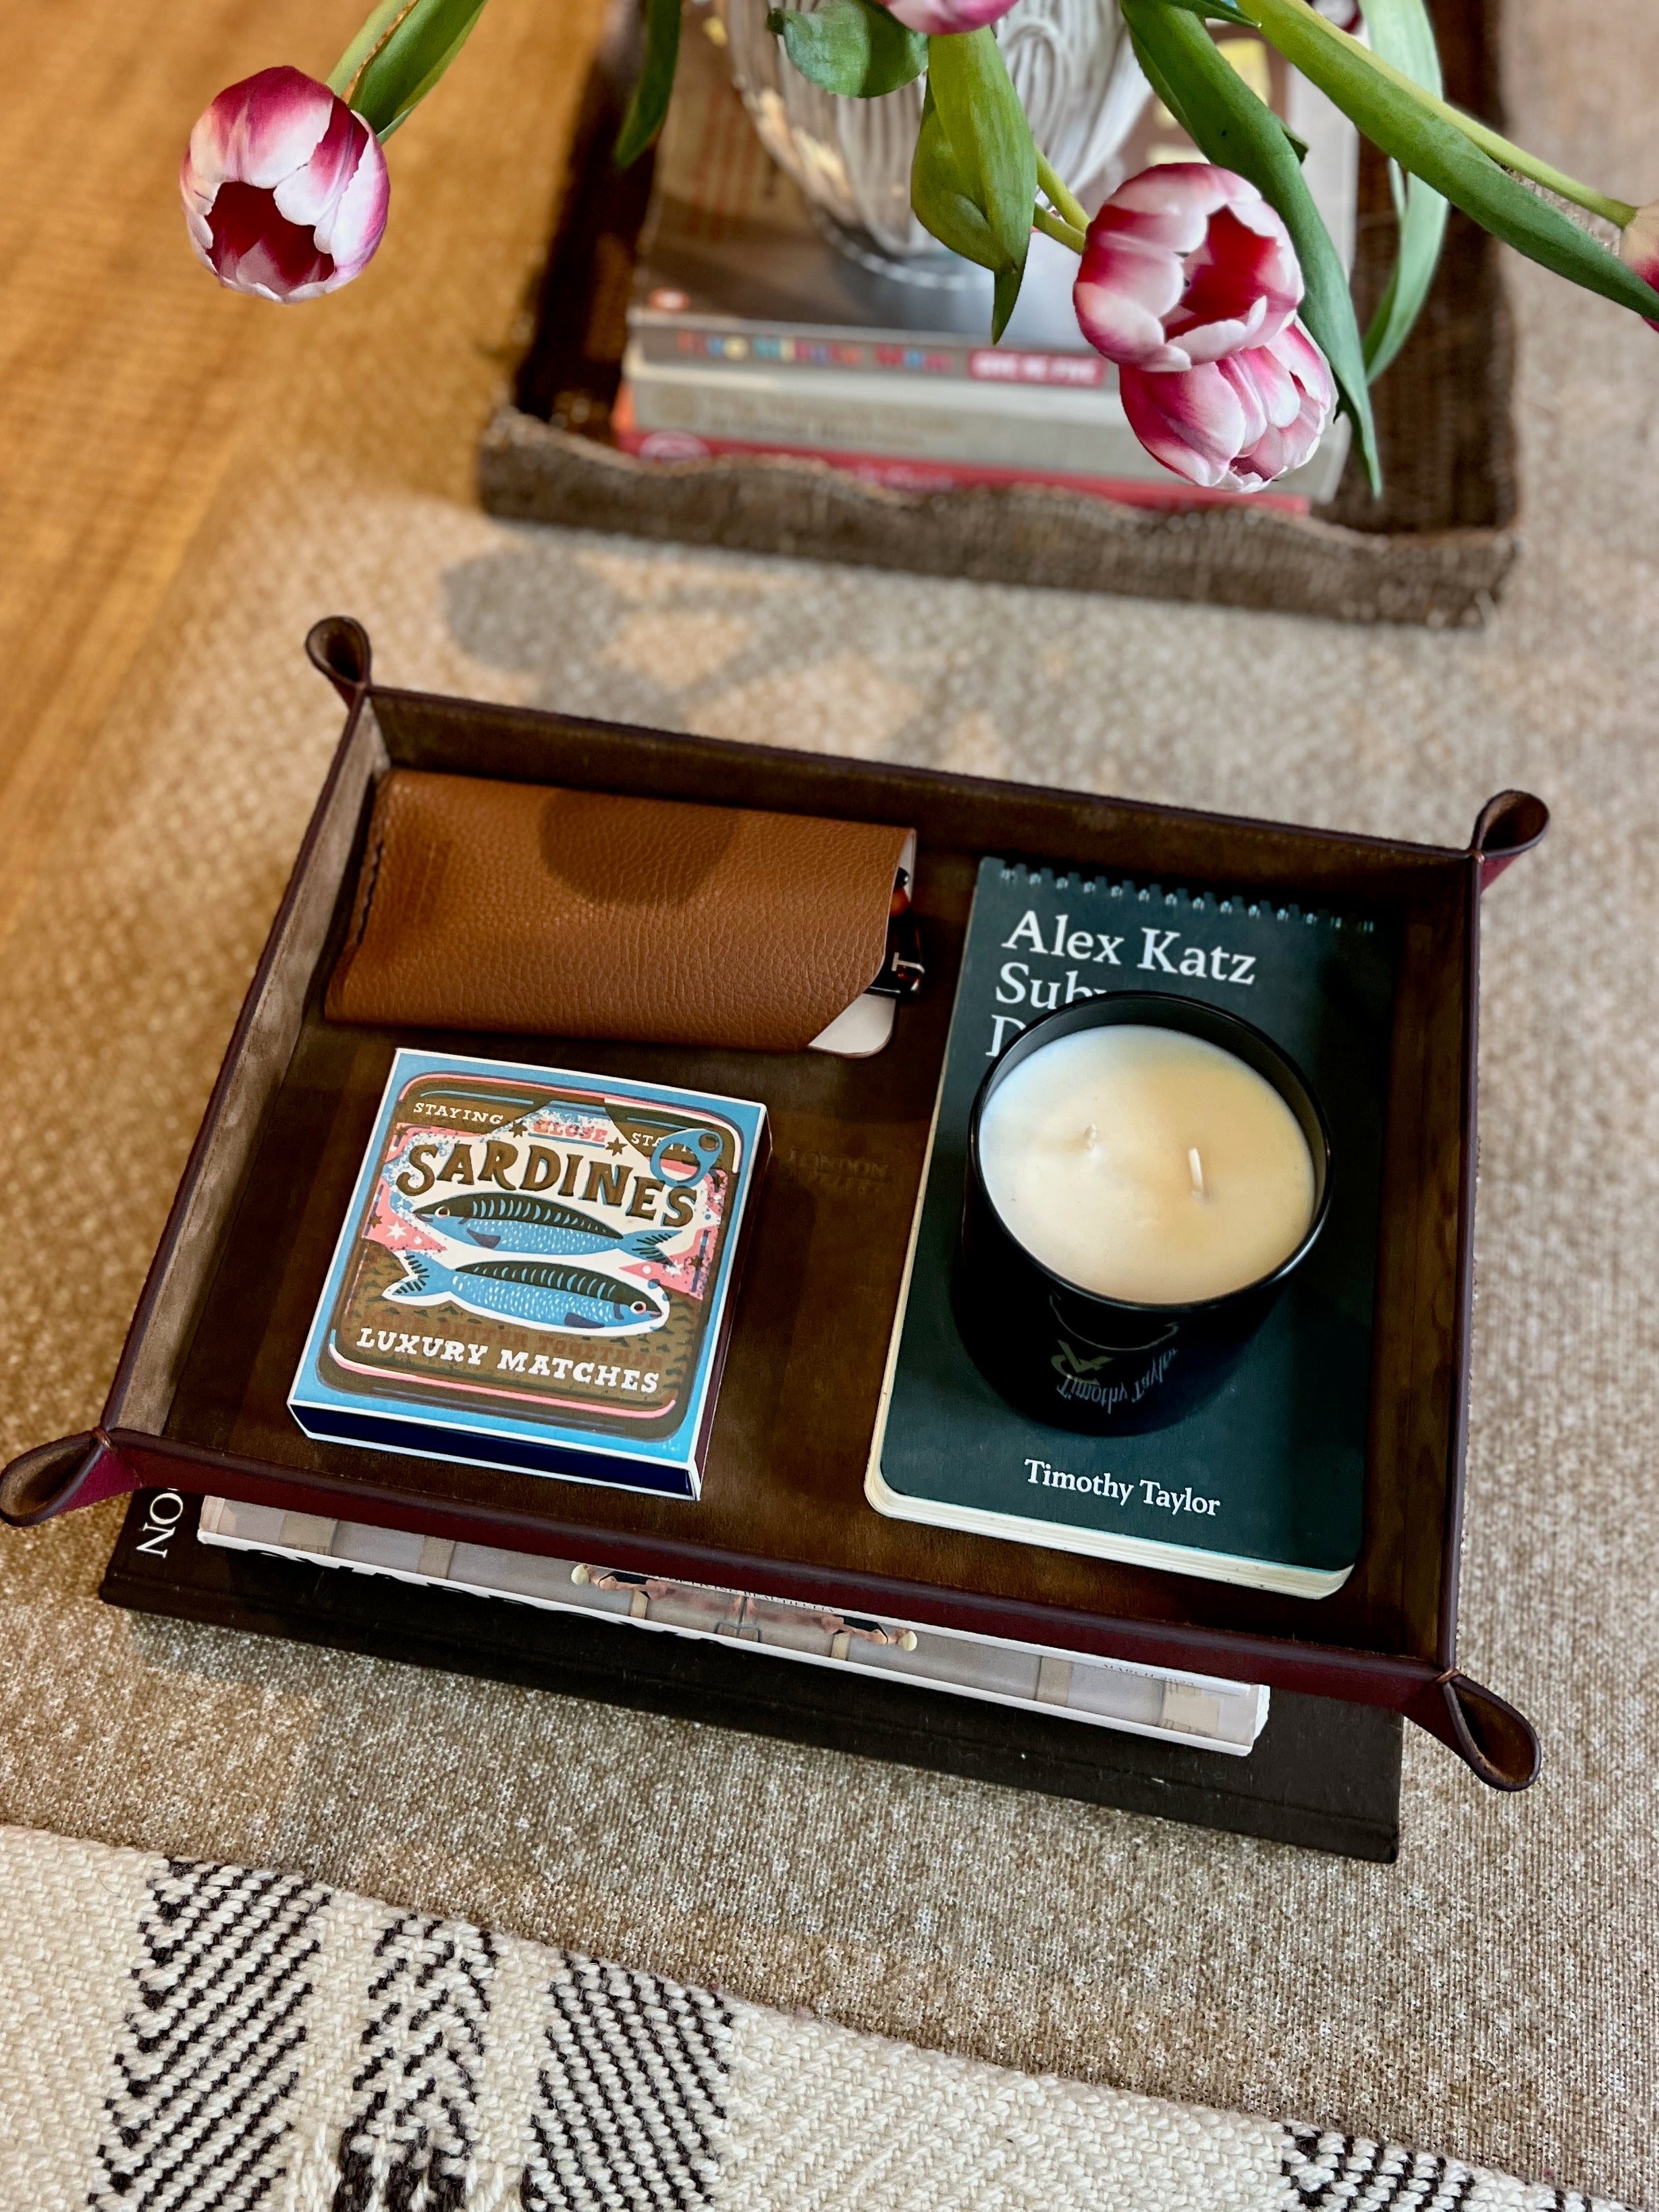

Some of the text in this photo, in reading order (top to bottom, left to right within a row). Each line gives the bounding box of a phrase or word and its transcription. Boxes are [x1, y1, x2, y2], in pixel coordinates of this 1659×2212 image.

[1001, 910, 1256, 985] Alex Katz
[412, 1102, 504, 1125] STAYING
[534, 1119, 607, 1142] CLOSE
[396, 1140, 697, 1228] SARDINES
[356, 1327, 660, 1394] LUXURY MATCHES
[1025, 1458, 1220, 1516] Timothy Taylor
